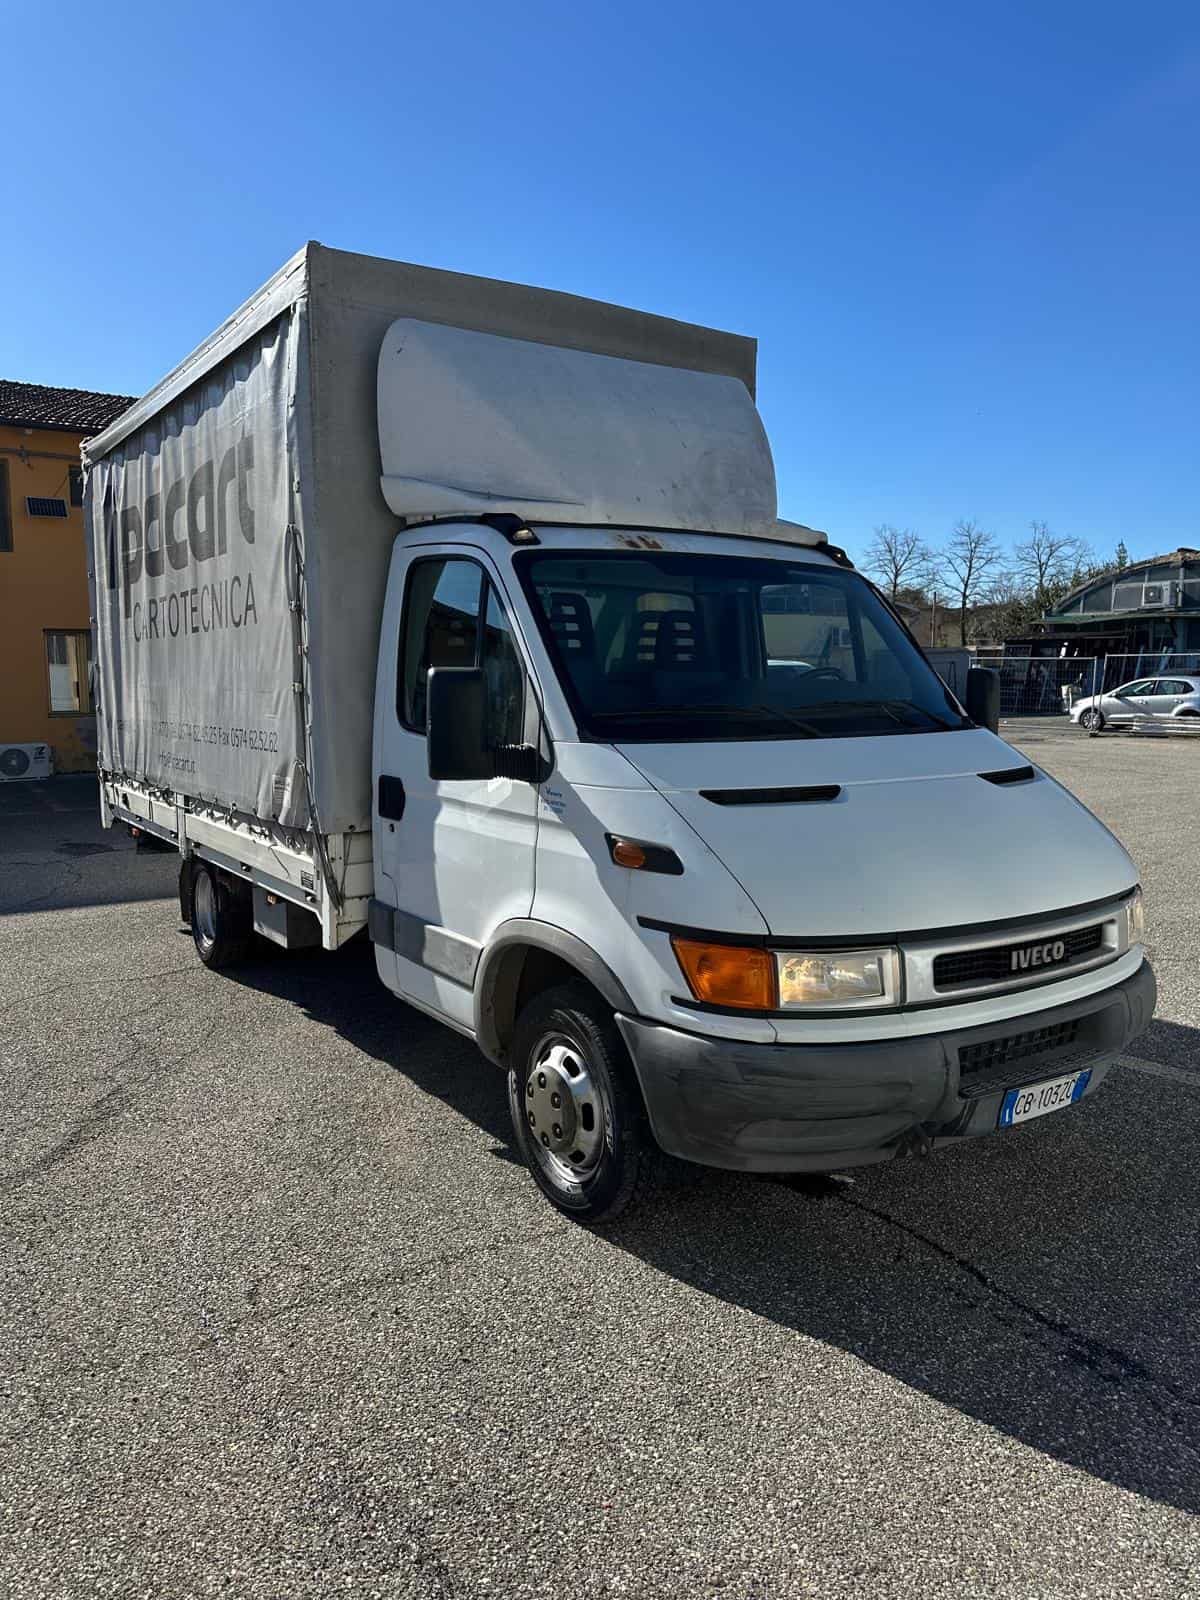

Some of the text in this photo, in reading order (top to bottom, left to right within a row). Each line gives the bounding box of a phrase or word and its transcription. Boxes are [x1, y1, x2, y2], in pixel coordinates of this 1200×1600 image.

[133, 573, 257, 642] CARTOTECNICA
[231, 728, 248, 748] 0574
[1010, 941, 1065, 970] IVECO
